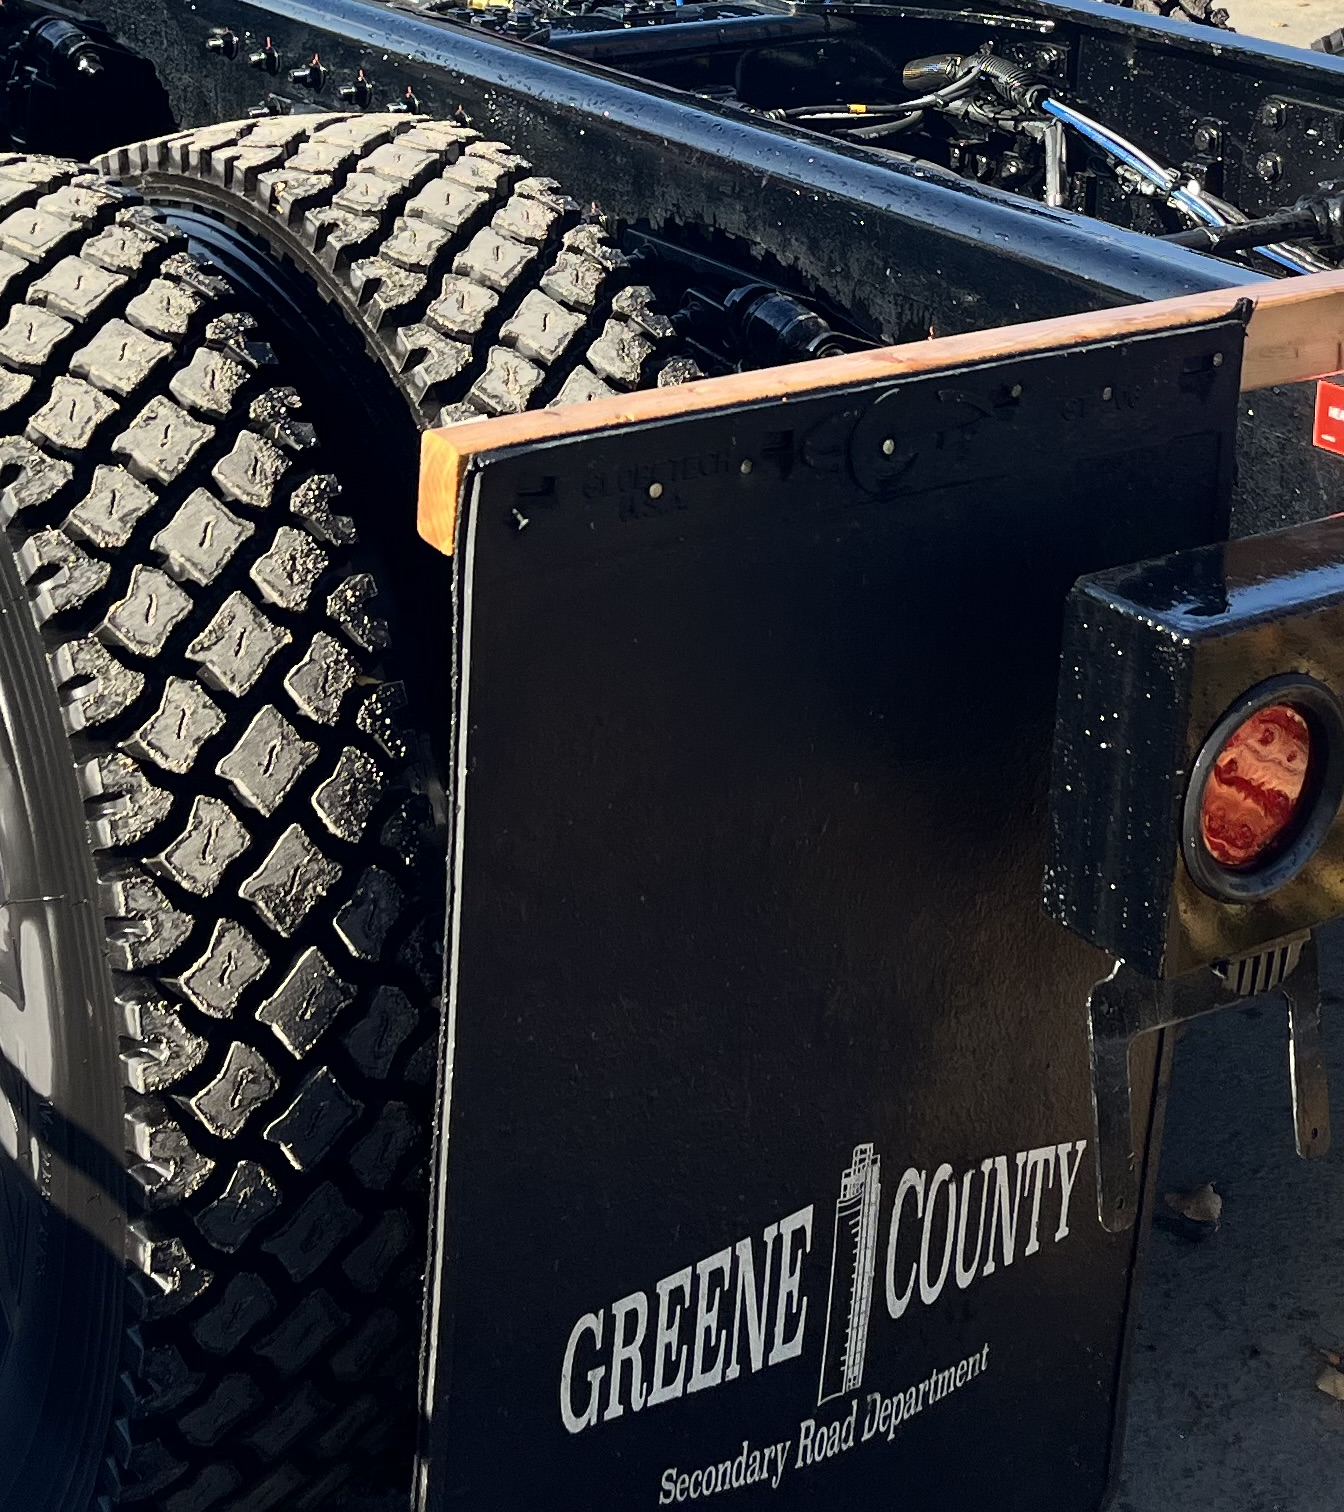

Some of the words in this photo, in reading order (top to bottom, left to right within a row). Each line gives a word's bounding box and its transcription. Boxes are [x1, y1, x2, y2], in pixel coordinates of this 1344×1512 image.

[560, 1202, 815, 1435] GREENE
[885, 1139, 1088, 1319] COUNTY
[658, 1439, 792, 1506] Secondary
[795, 1397, 858, 1470] Road
[860, 1341, 991, 1442] Department
